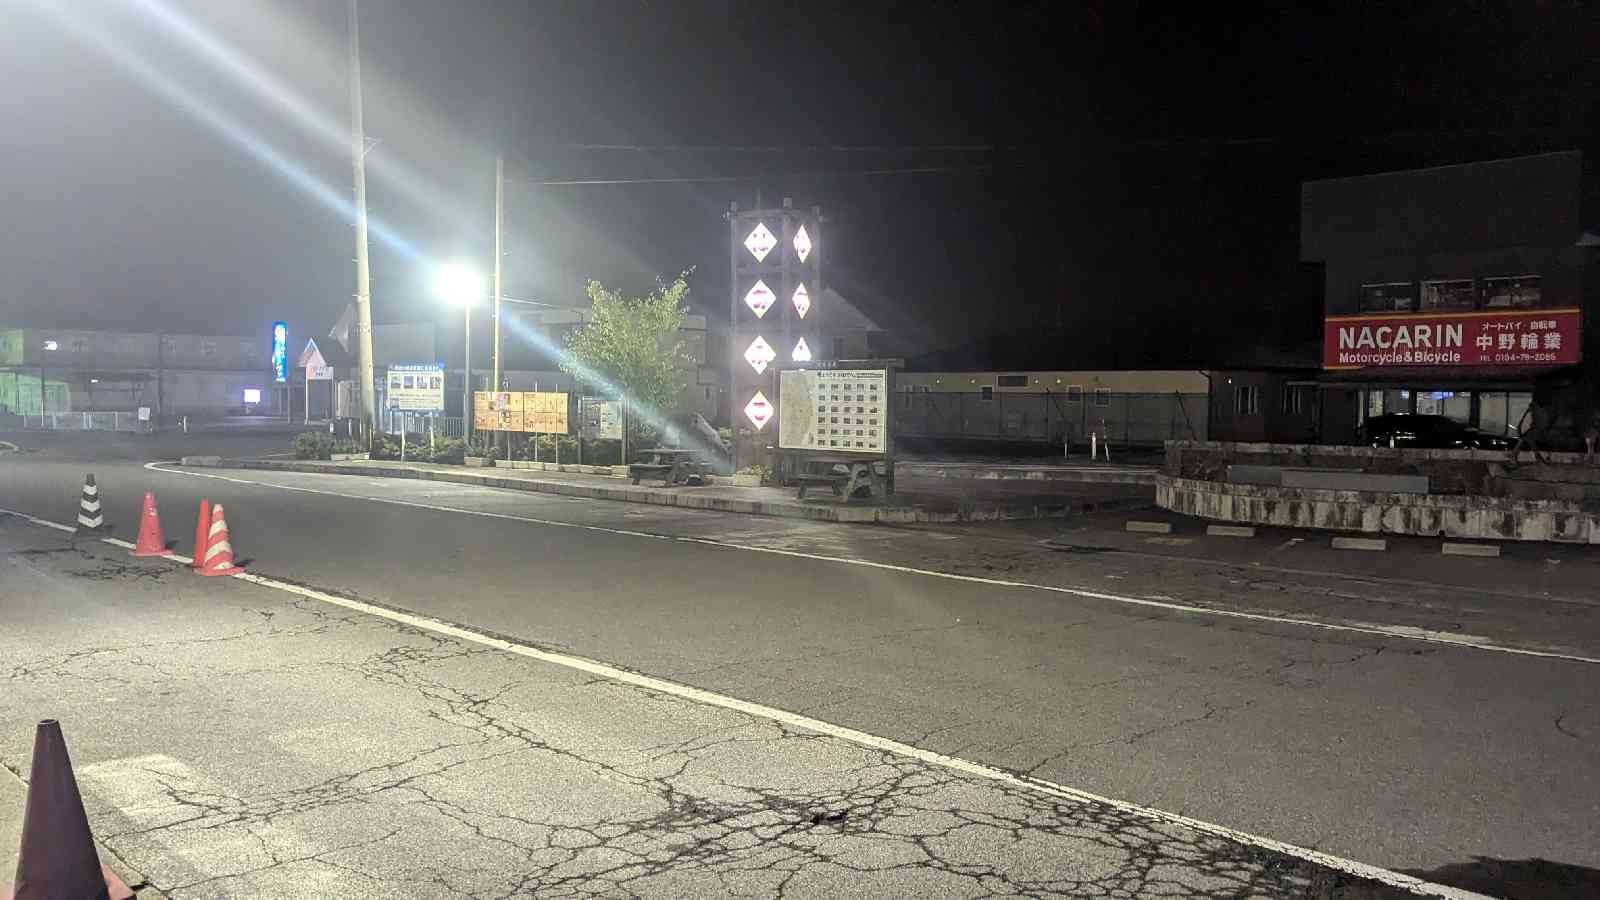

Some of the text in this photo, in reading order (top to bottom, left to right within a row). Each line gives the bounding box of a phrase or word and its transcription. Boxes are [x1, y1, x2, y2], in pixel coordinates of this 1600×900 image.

[1340, 323, 1463, 350] NACARIN
[1476, 332, 1561, 351] 中野輪業
